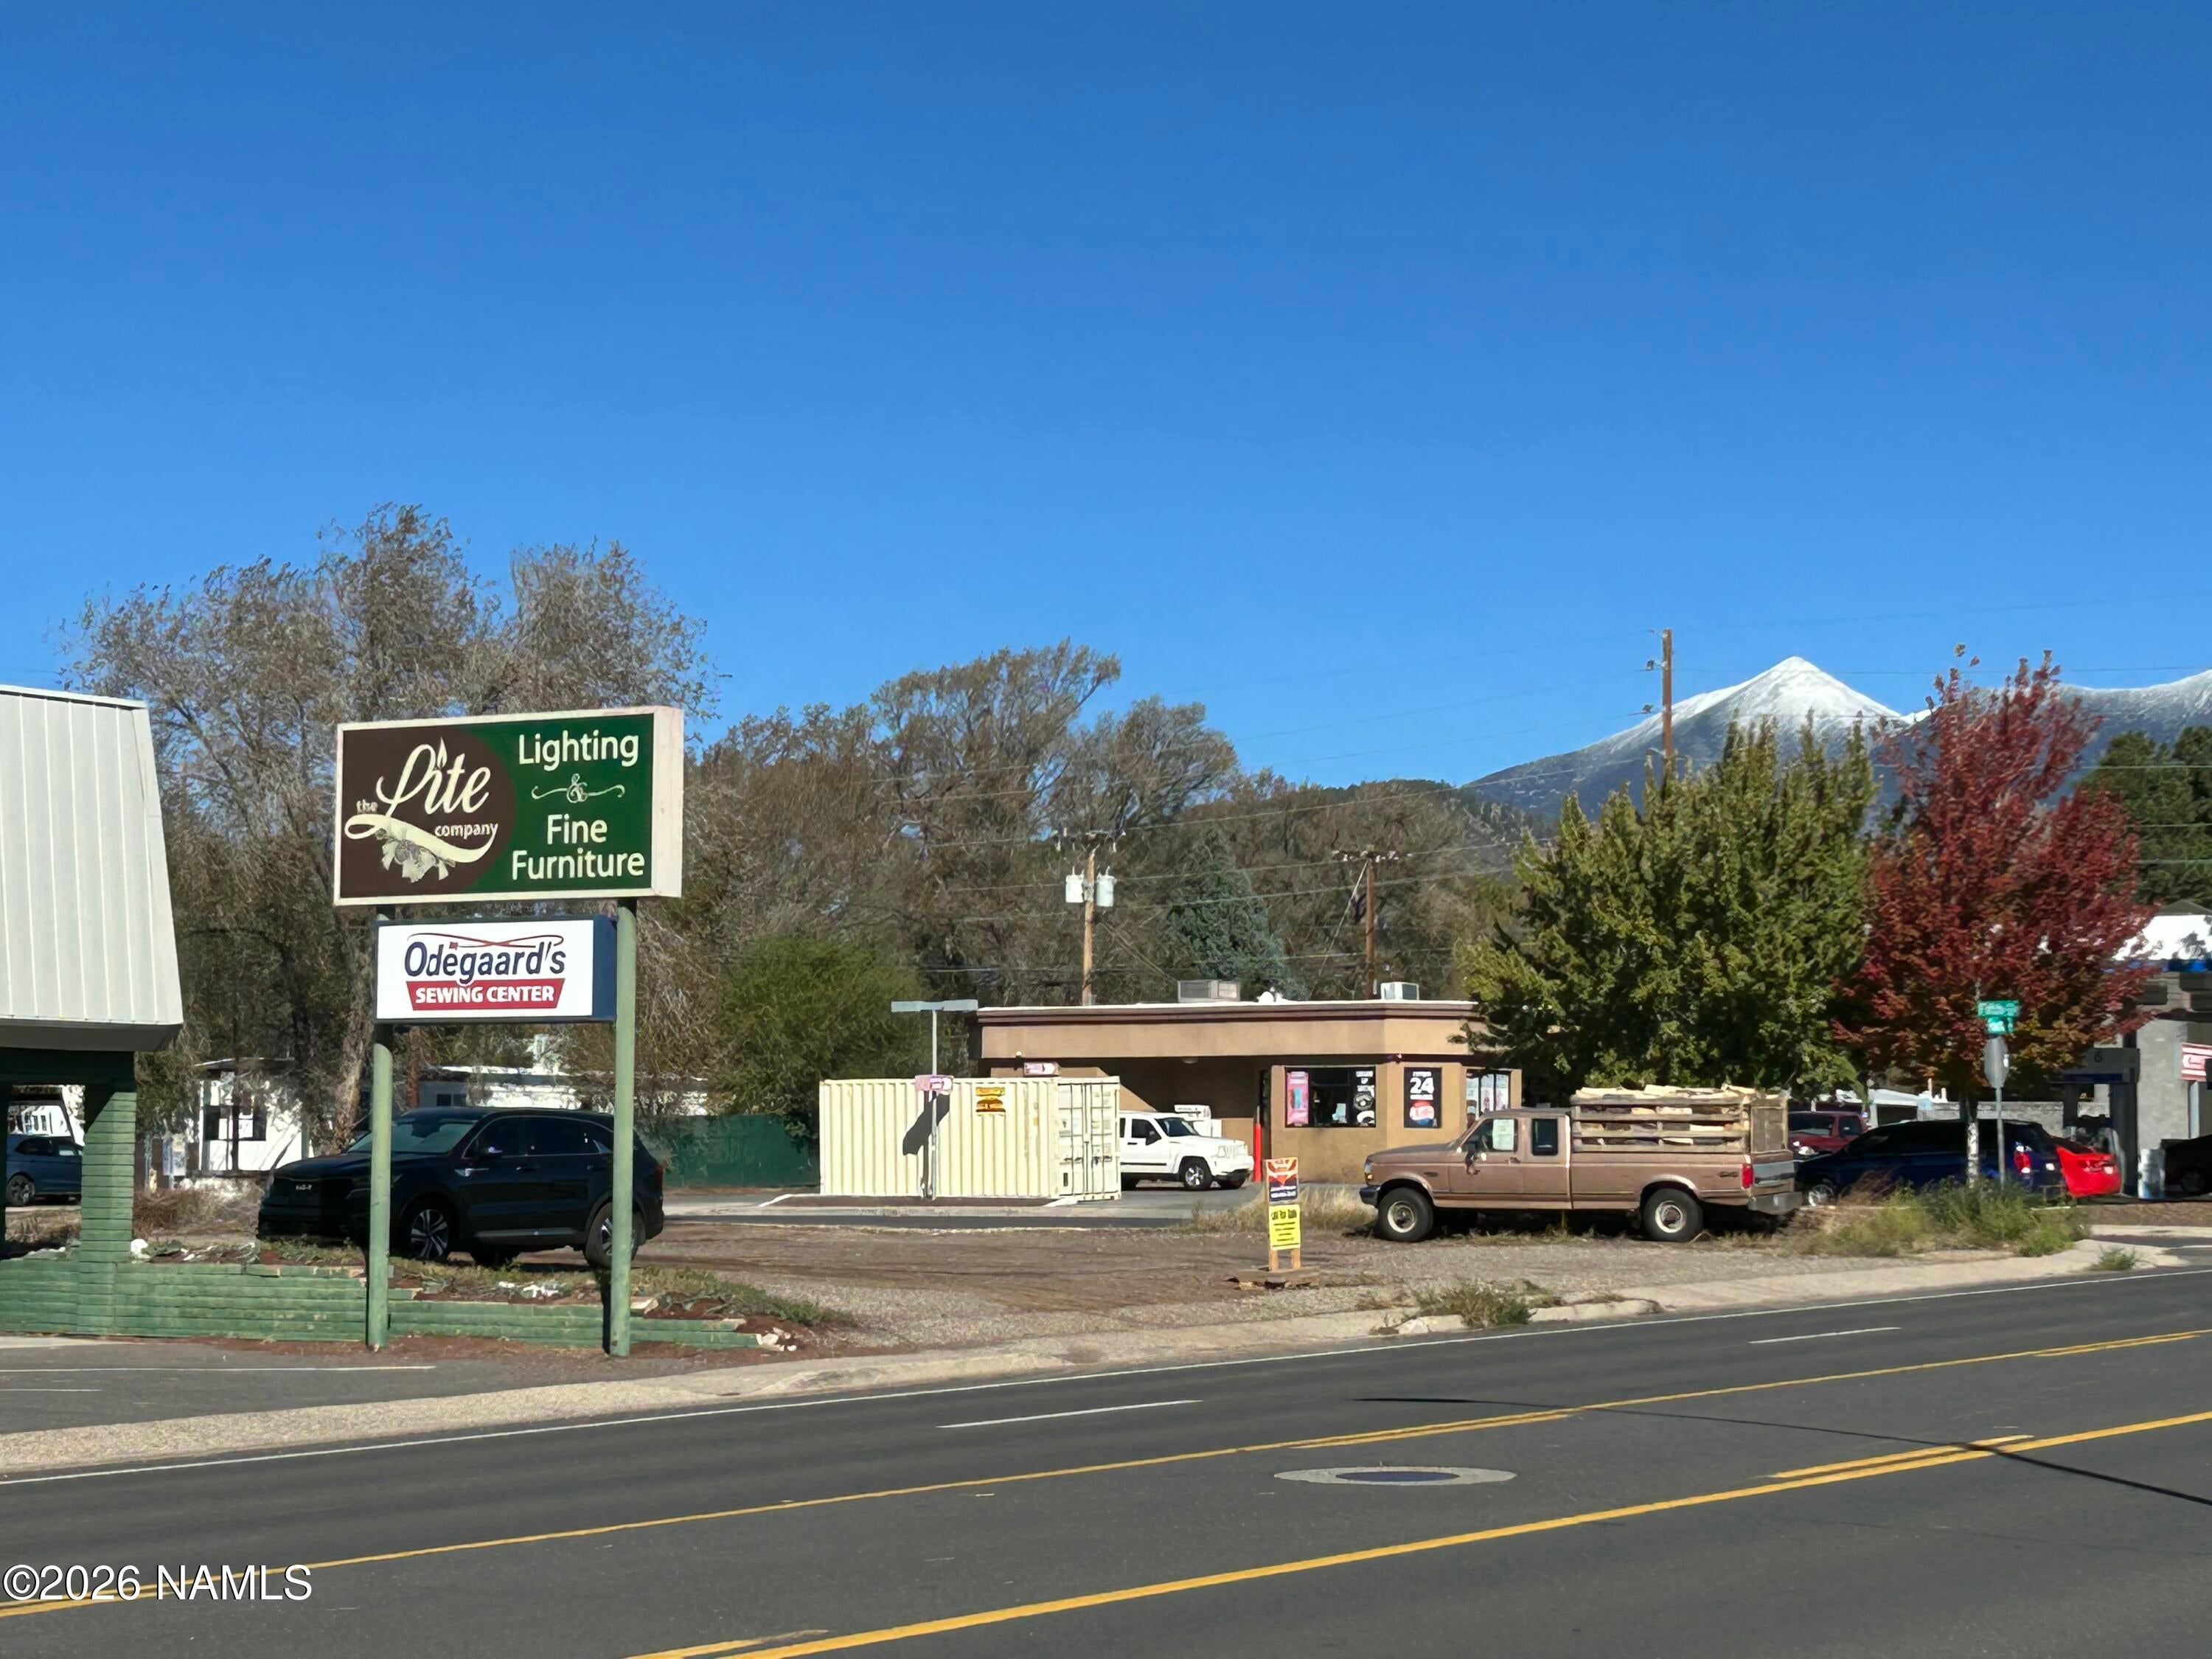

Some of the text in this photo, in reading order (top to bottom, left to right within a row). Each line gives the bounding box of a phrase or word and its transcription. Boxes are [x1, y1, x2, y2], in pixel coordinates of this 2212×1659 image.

[518, 729, 639, 771] Lighting
[376, 737, 492, 818] Lite
[566, 773, 588, 804] &
[356, 799, 378, 814] the
[434, 823, 499, 841] company
[547, 813, 608, 845] Fine
[512, 847, 645, 880] Furniture
[405, 941, 567, 985] Odegaard's
[415, 985, 555, 1004] SEWING CENTER
[1409, 1077, 1435, 1094] 24
